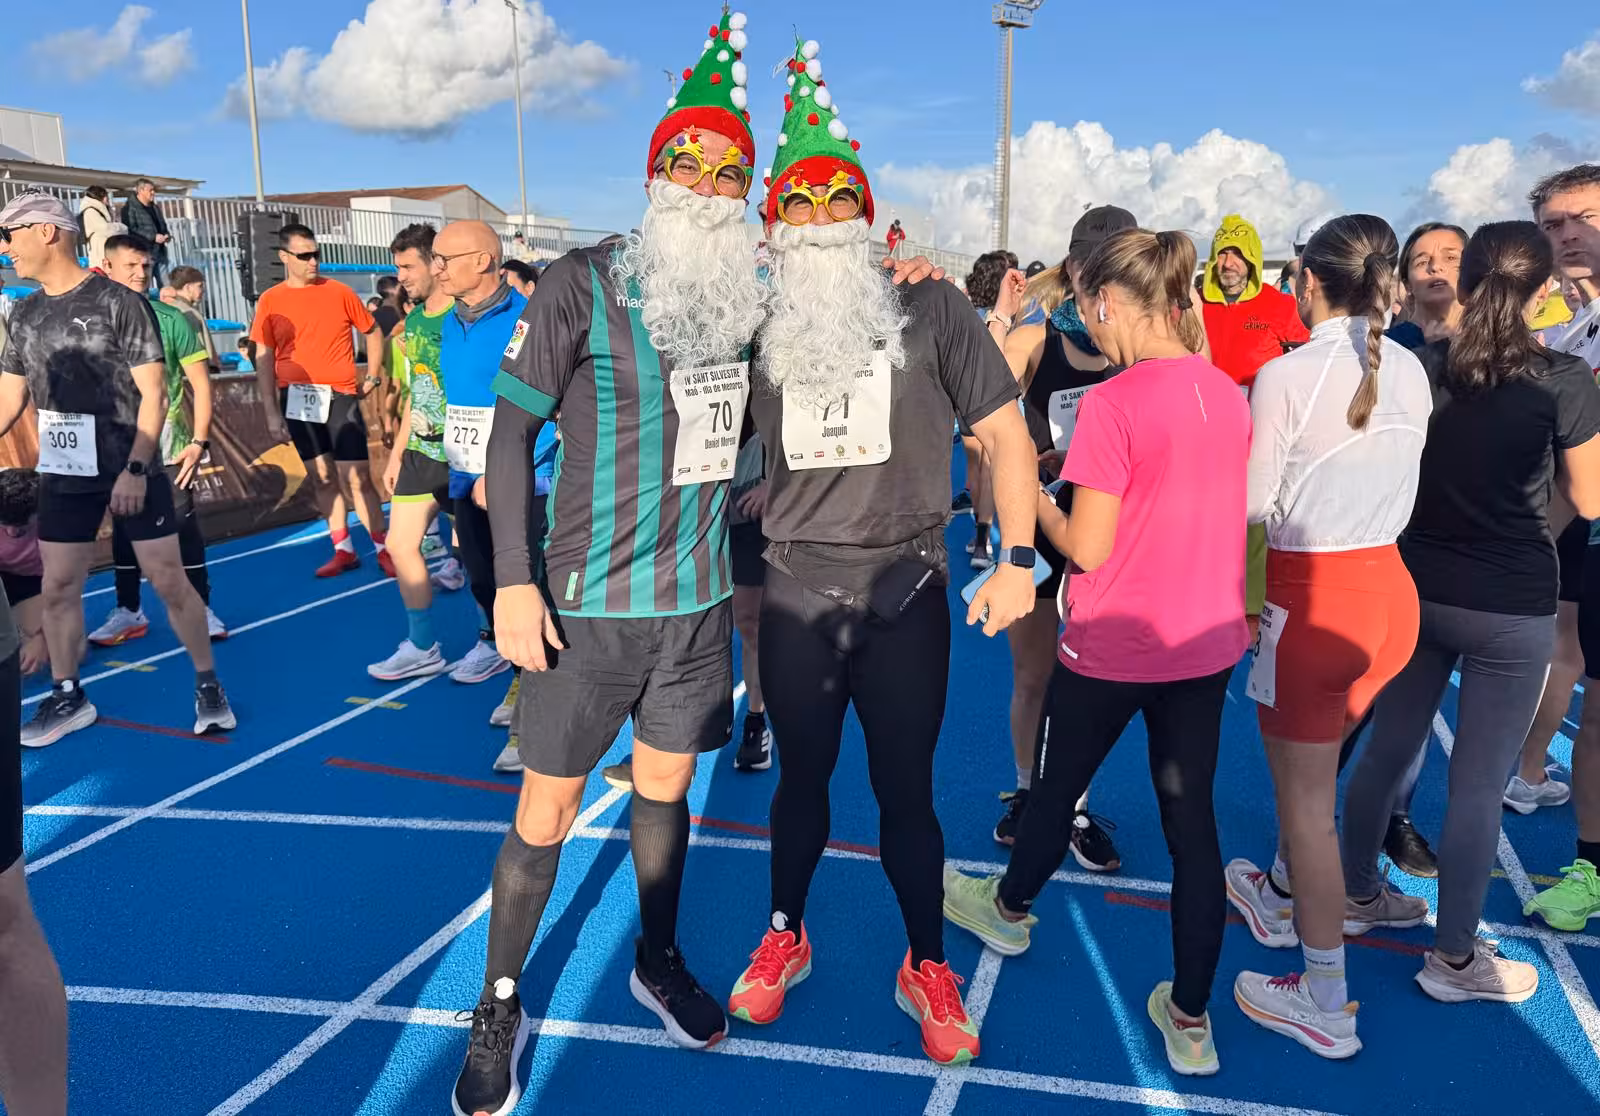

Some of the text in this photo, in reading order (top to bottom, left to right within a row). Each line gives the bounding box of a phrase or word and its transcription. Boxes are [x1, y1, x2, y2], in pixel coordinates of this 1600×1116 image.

[616, 295, 647, 309] mac
[684, 367, 740, 386] IV SANT SILVESTRE
[854, 369, 874, 379] orca
[684, 386, 698, 398] Maó
[702, 385, 713, 395] Illa
[713, 384, 721, 393] de
[721, 381, 744, 392] Menorca
[1069, 390, 1085, 400] SANT
[303, 393, 316, 405] 10
[708, 400, 732, 433] 70
[48, 431, 78, 449] 309
[453, 426, 480, 446] 272
[704, 437, 720, 450] Daniel
